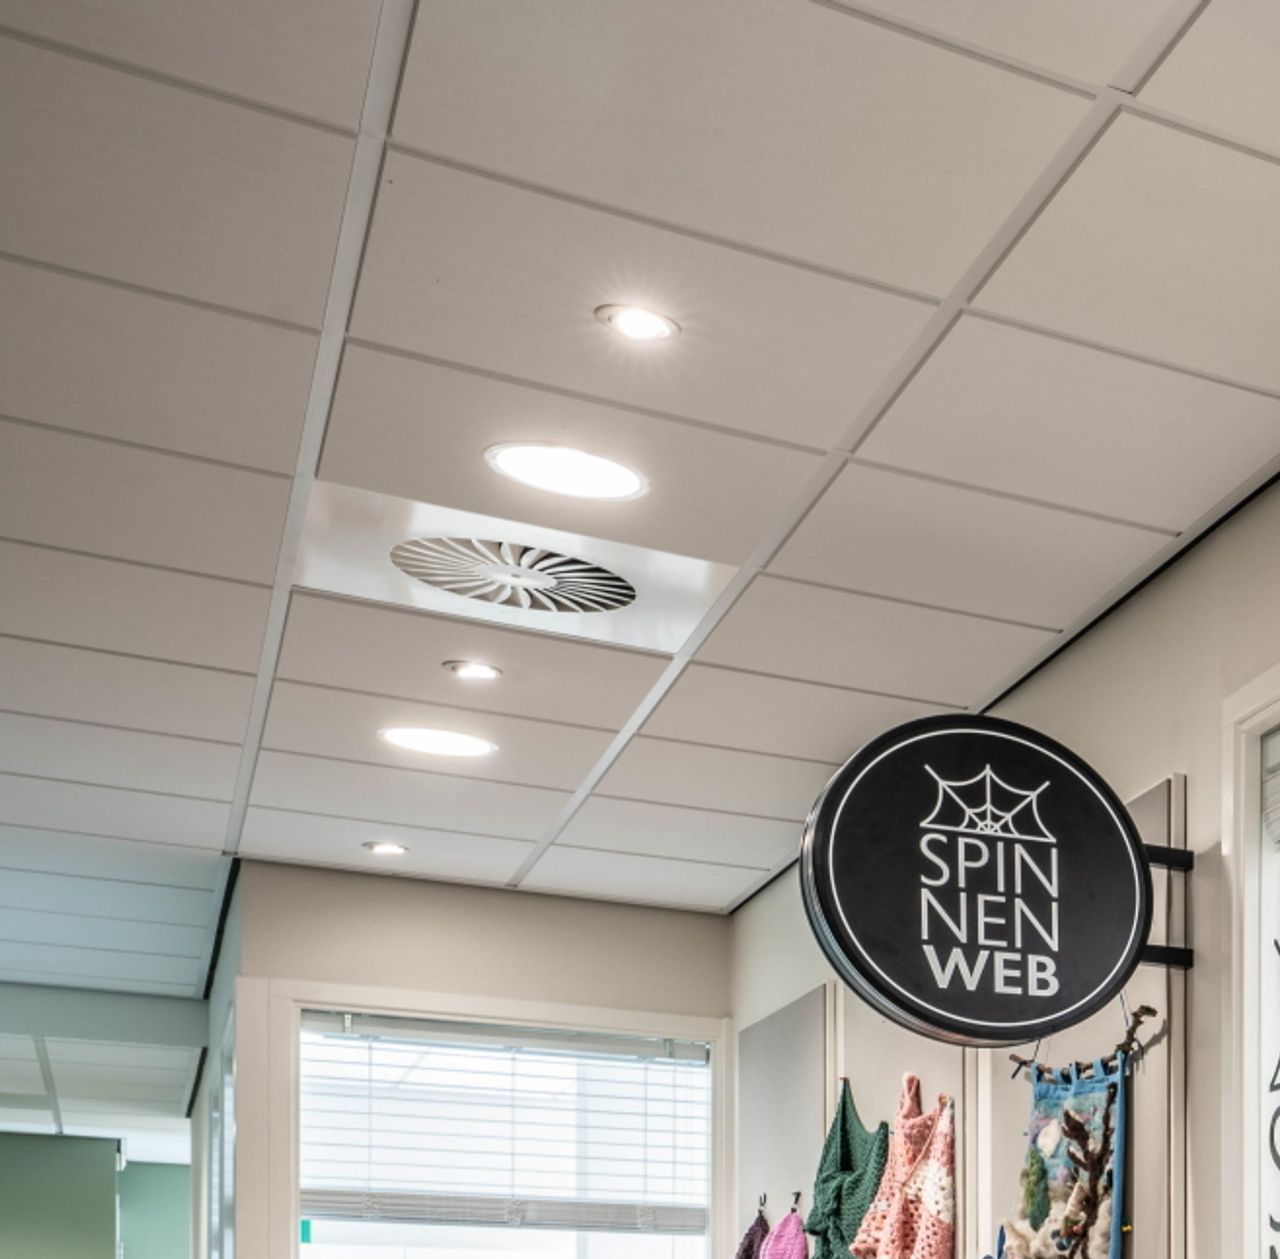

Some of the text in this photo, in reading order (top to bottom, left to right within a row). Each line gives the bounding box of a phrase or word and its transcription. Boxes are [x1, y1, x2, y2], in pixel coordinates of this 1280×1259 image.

[919, 832, 1059, 899] SPIN
[920, 888, 1059, 952] NEN
[922, 945, 1060, 997] WEB
